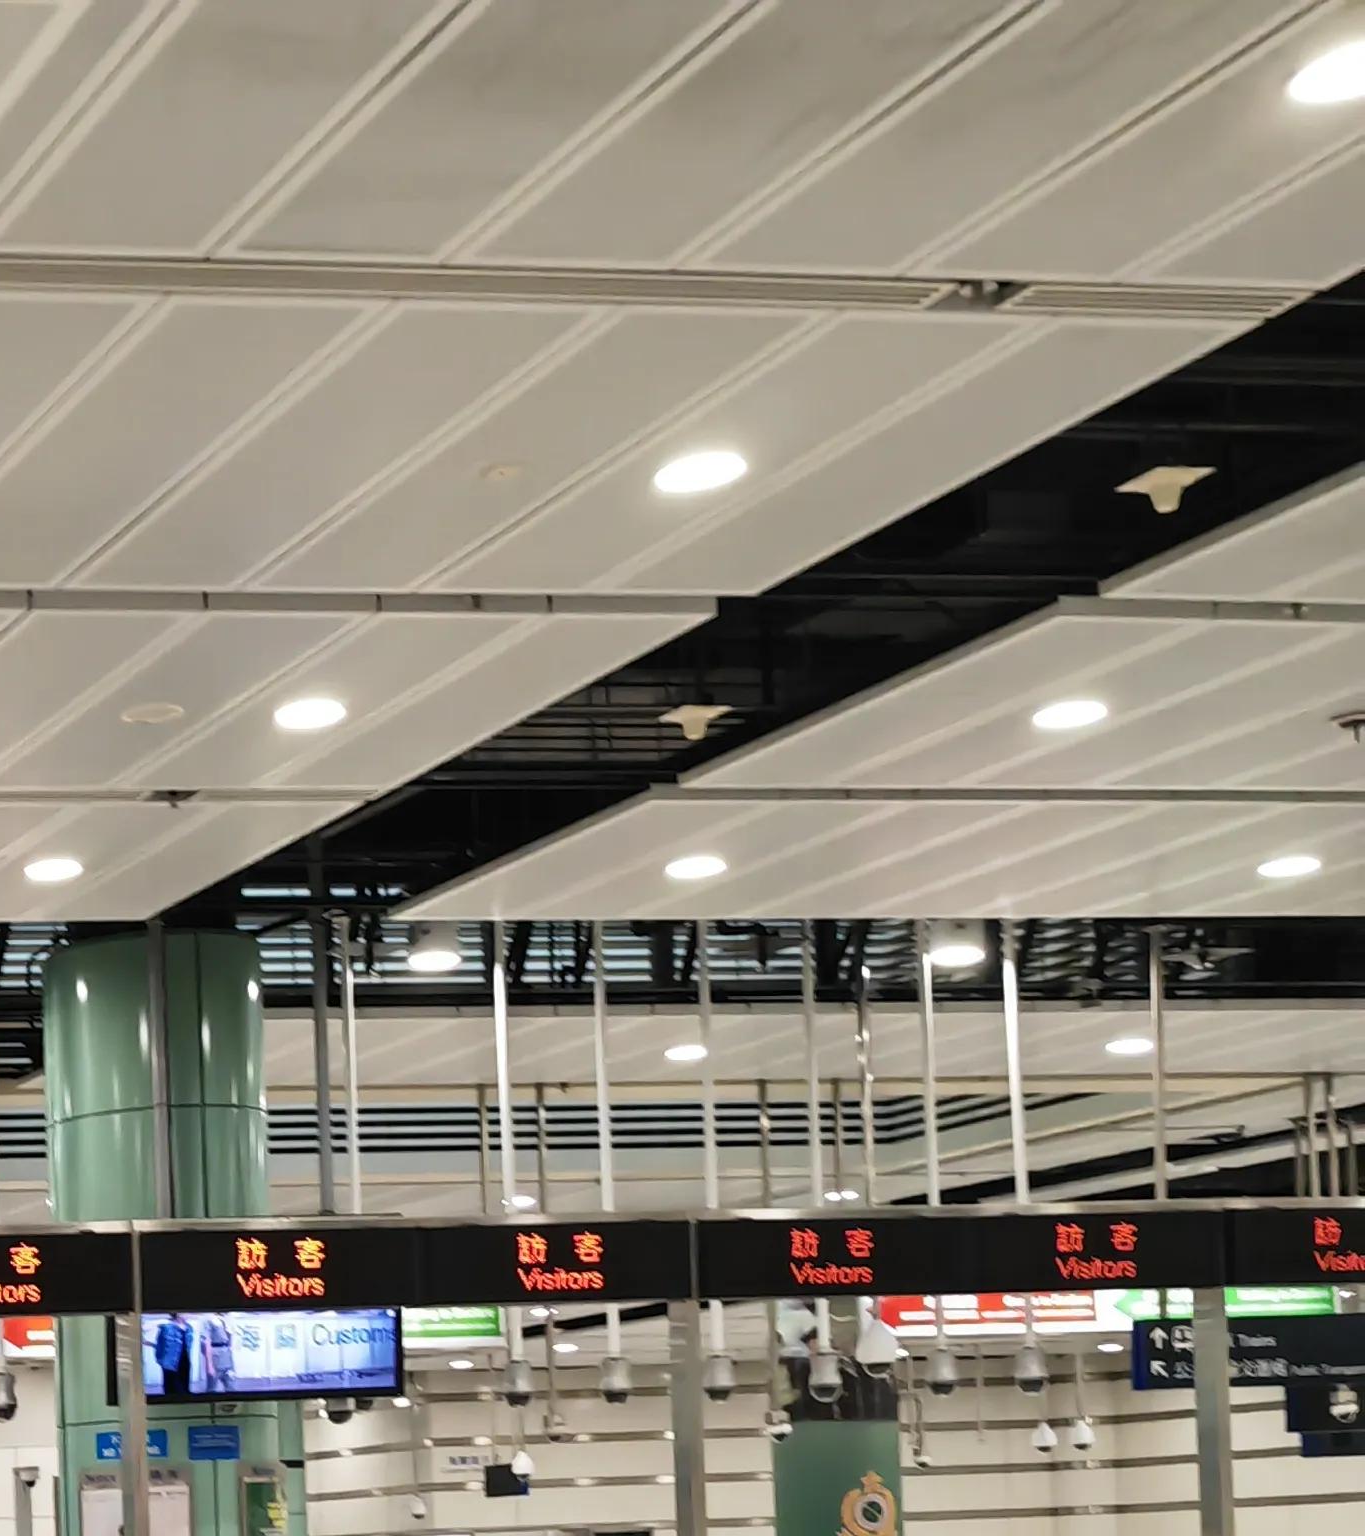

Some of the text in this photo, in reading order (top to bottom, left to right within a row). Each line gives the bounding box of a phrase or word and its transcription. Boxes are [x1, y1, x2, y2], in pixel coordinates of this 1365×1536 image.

[516, 1232, 604, 1264] 訪客
[790, 1228, 874, 1258] 訪客
[1055, 1222, 1138, 1252] 訪客
[236, 1238, 326, 1270] 訪客
[1313, 1250, 1365, 1272] Visit
[516, 1268, 604, 1291] Visitors
[790, 1262, 873, 1285] Visitors
[1055, 1257, 1137, 1280] Visitors
[236, 1273, 325, 1298] Visitors
